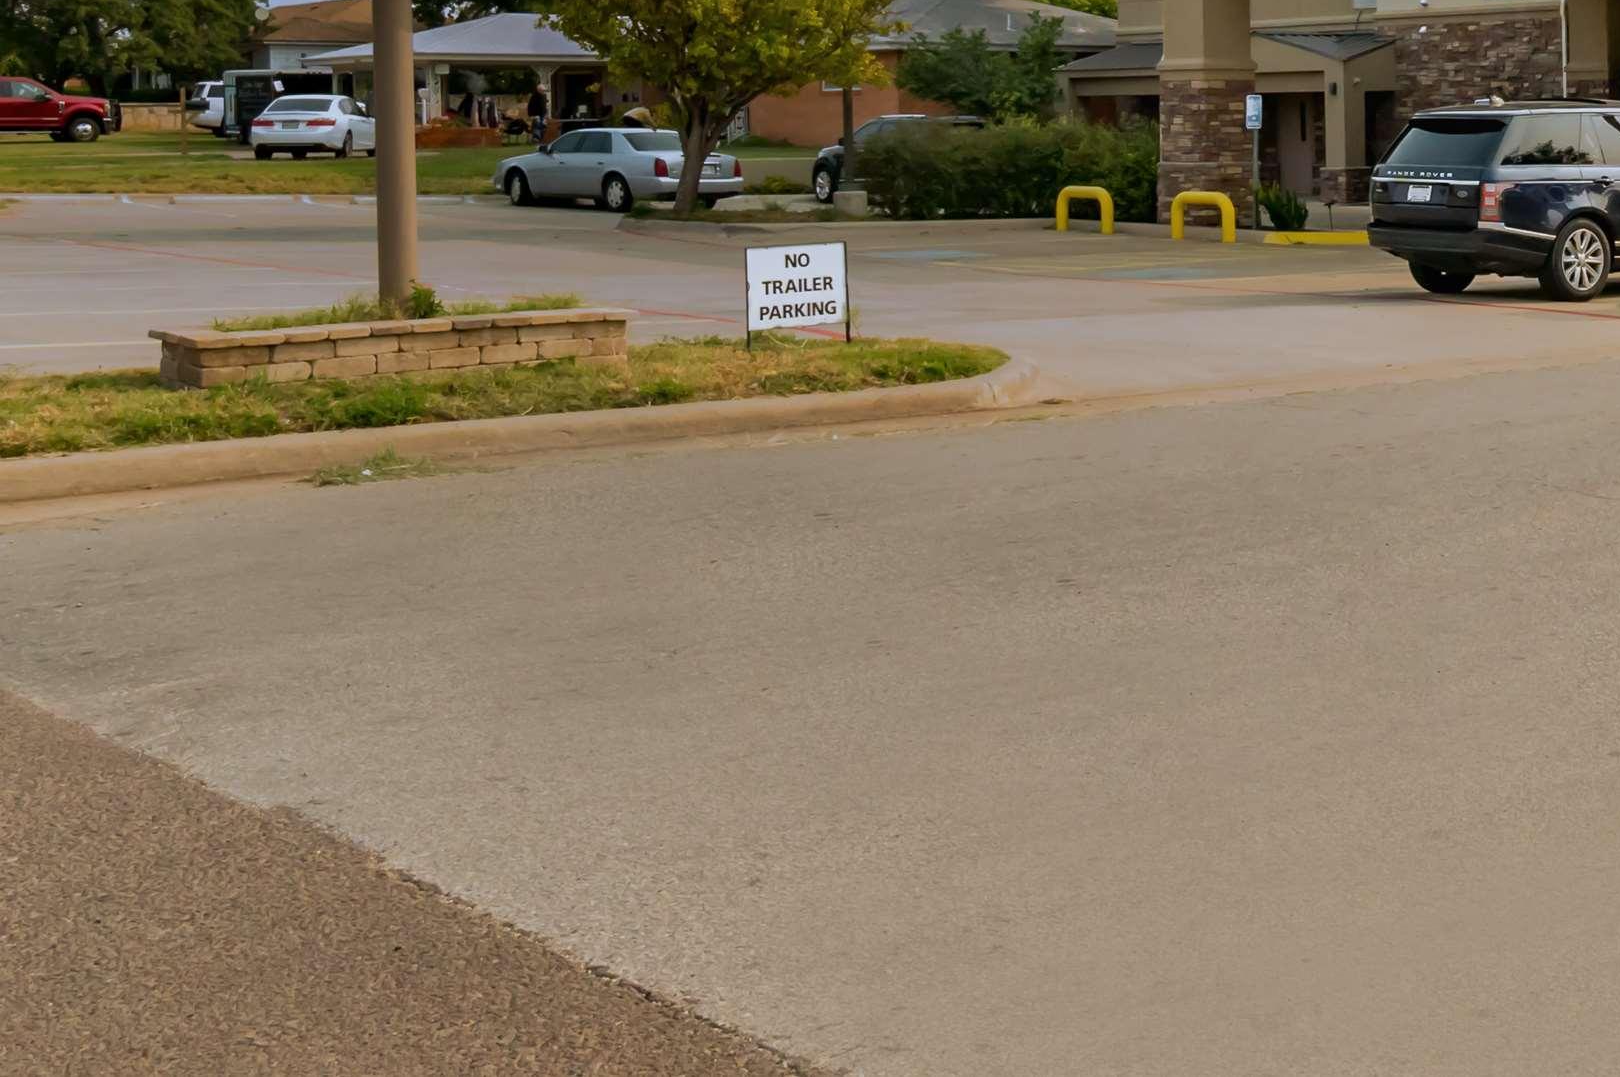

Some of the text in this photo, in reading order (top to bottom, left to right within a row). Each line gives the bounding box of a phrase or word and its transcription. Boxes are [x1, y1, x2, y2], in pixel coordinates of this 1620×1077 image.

[784, 253, 810, 269] NO
[762, 276, 834, 296] TRAILER
[759, 300, 837, 321] PARKING
